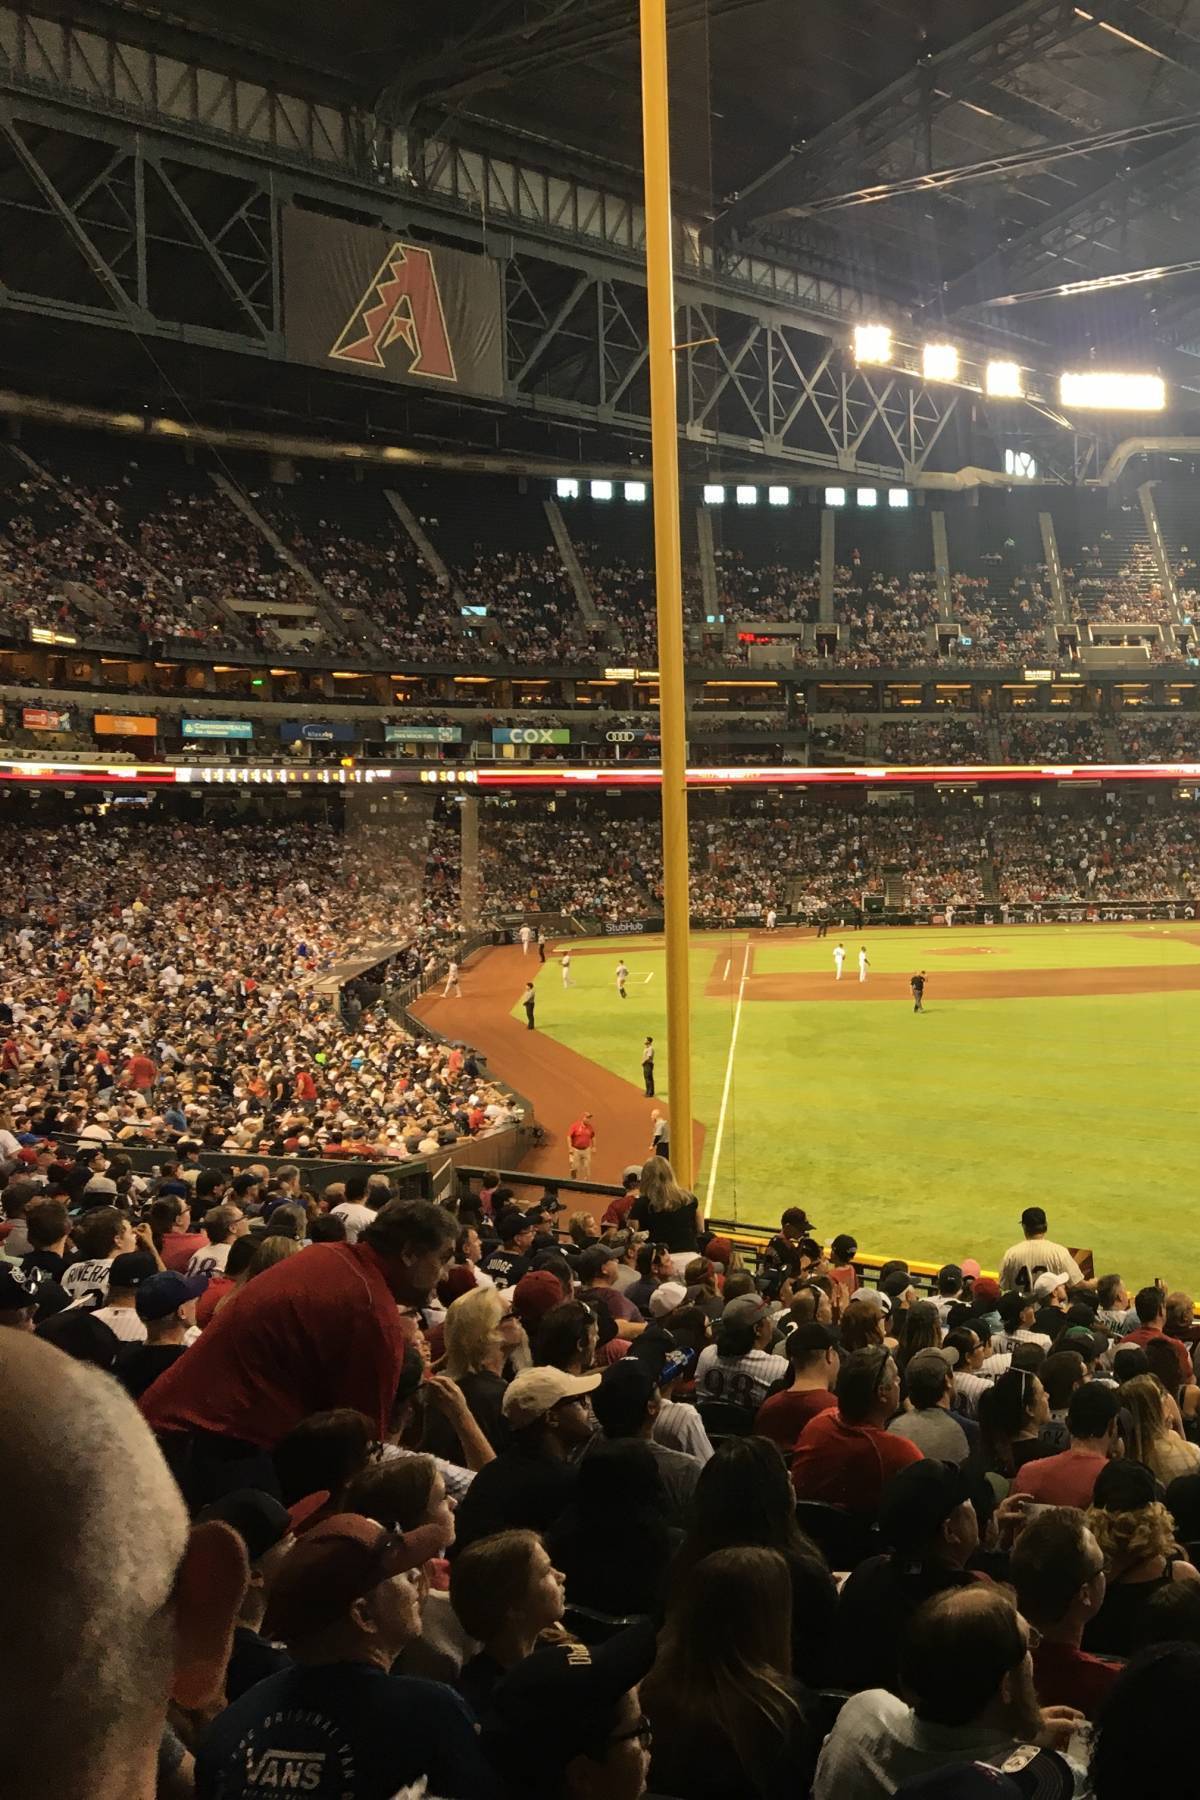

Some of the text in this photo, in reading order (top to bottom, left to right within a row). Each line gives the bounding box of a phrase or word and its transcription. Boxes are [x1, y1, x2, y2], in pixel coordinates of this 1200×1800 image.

[510, 728, 554, 743] COX
[605, 922, 643, 932] StubHub
[67, 1263, 109, 1284] RIVERA
[486, 1258, 512, 1274] JUDGE
[247, 1748, 326, 1791] VANS
